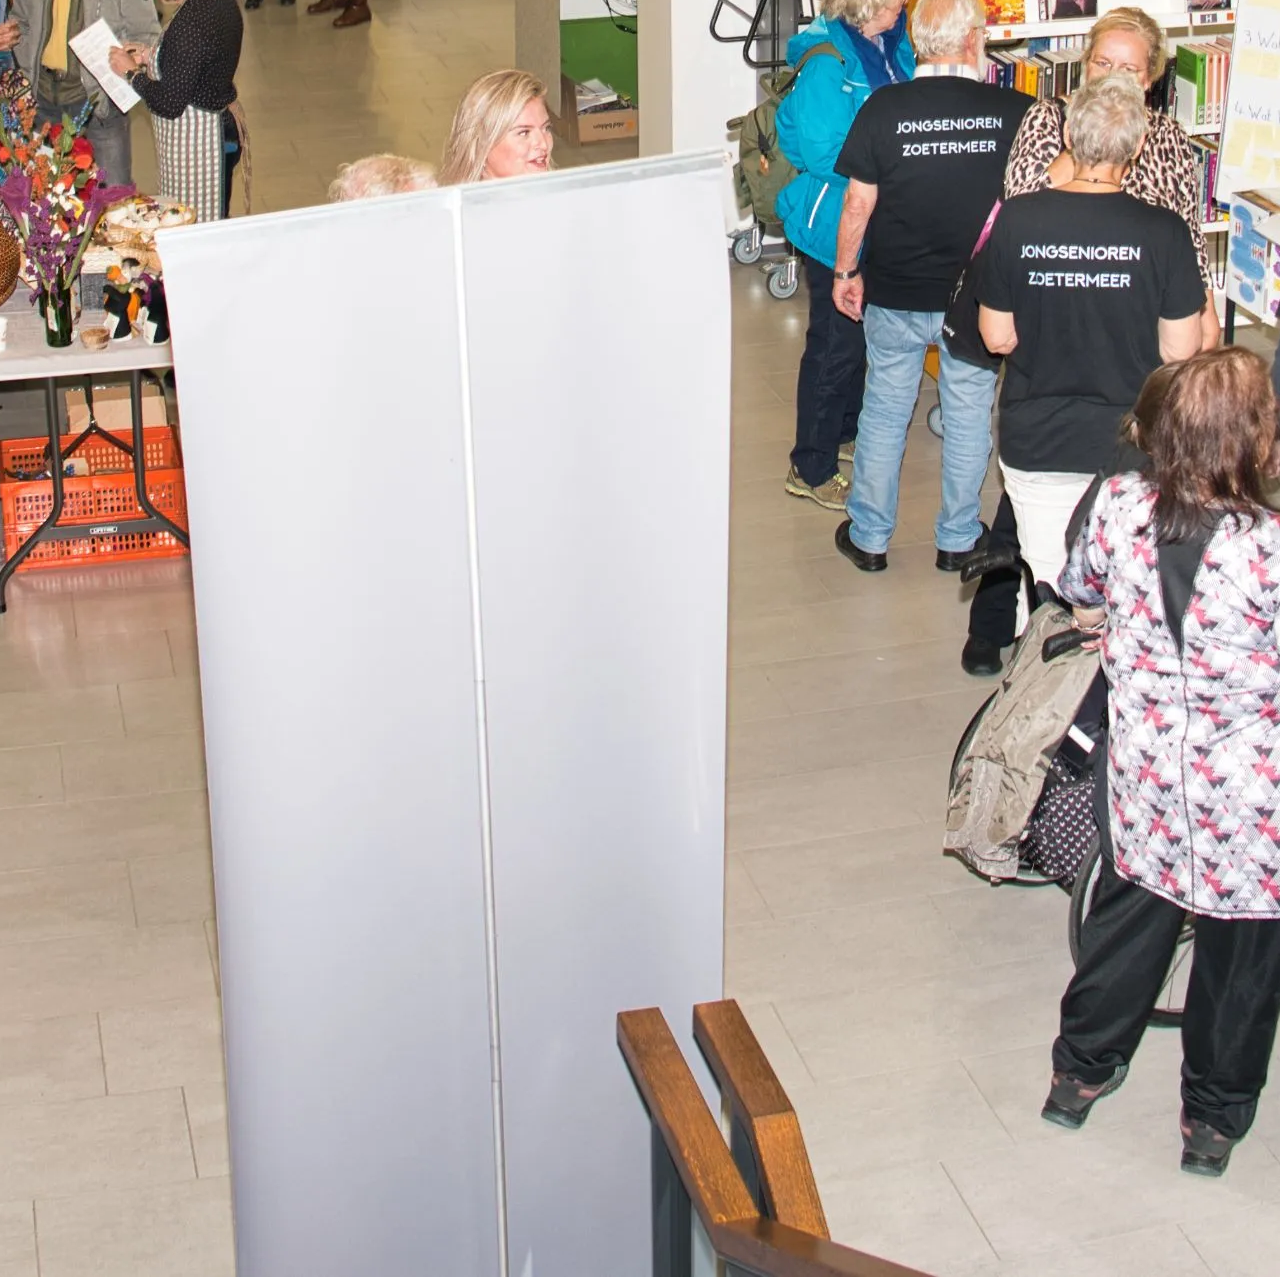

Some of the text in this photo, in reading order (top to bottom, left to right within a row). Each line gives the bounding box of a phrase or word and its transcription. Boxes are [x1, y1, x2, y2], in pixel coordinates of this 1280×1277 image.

[1249, 105, 1271, 121] Wat
[896, 117, 1002, 135] JONGSENIOREN
[902, 140, 996, 157] ZOETERMEER
[1021, 244, 1141, 261] JONGSENIOREN
[1028, 270, 1131, 288] ZOETERMEER
